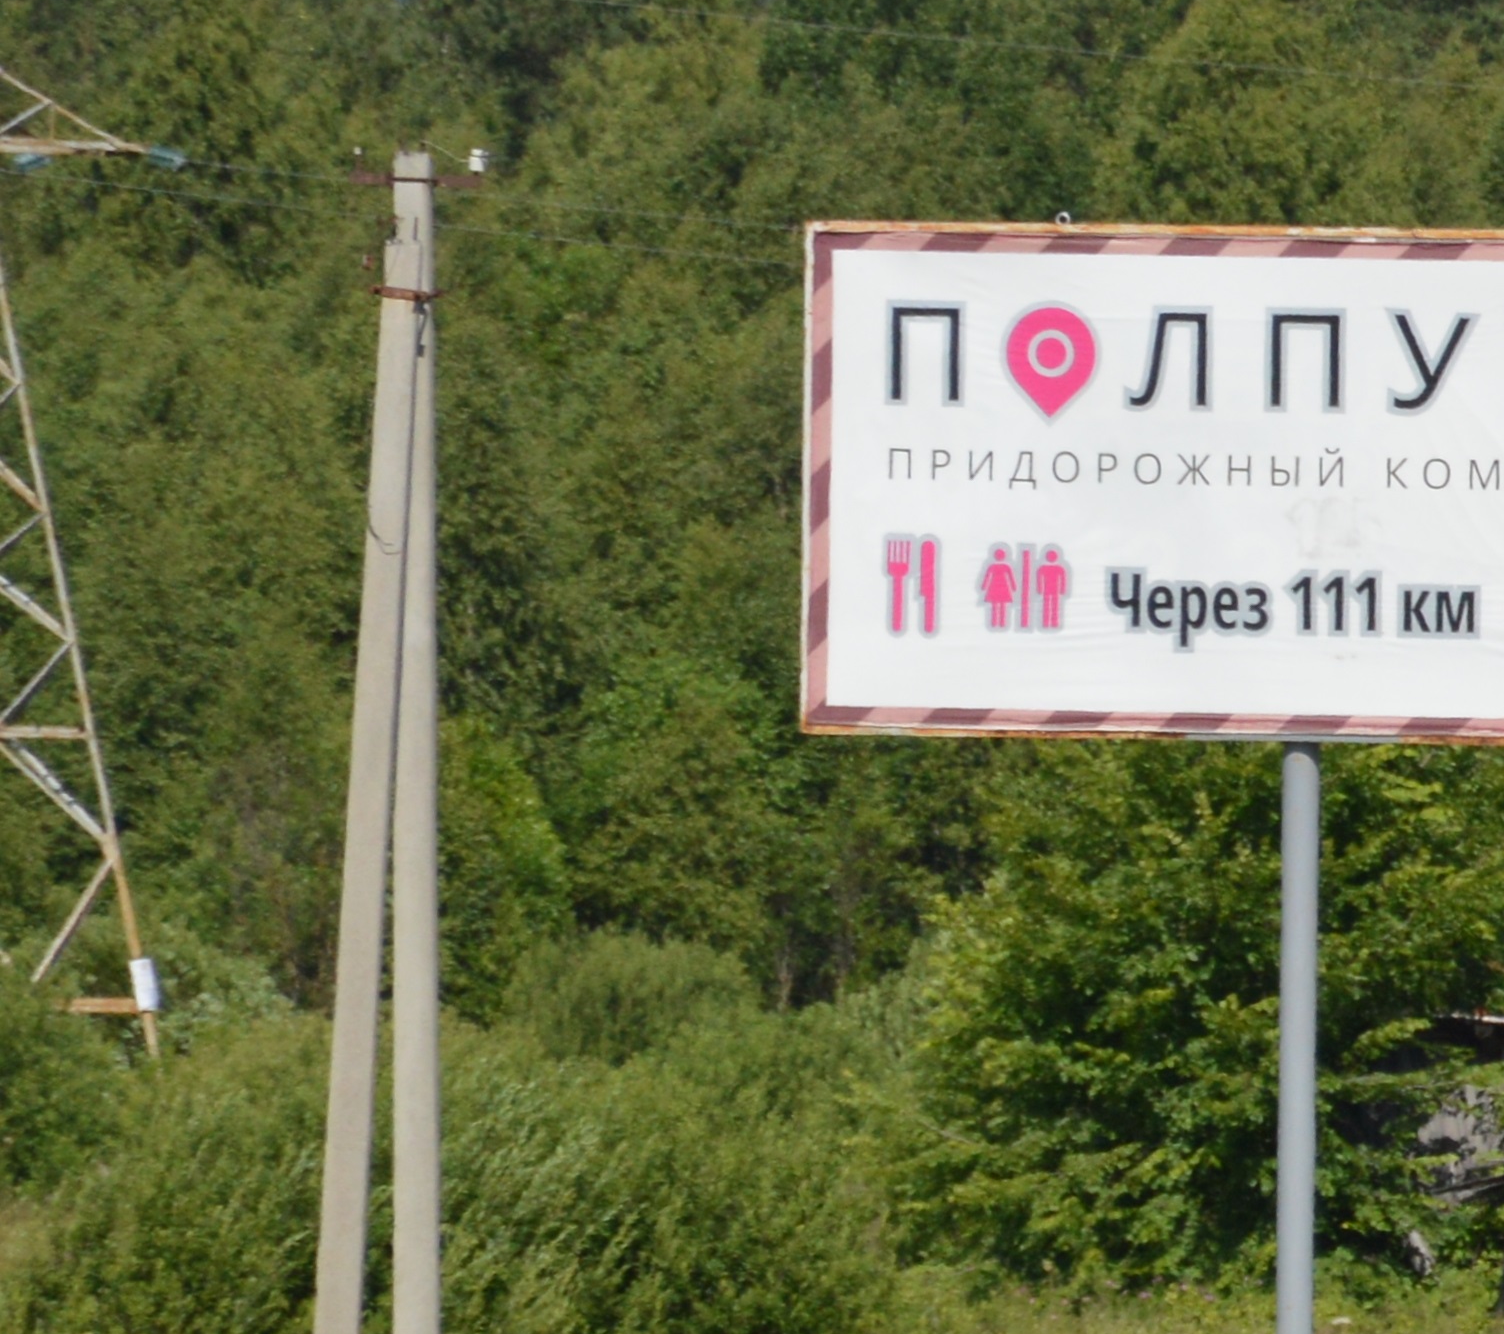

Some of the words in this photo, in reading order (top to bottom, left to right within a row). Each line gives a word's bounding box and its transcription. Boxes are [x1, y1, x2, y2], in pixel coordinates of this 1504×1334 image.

[886, 446, 1346, 491] ПРИДОРОЖНЫЙ
[1109, 571, 1270, 648] Через
[1290, 575, 1378, 632] 111
[1402, 588, 1477, 634] км
